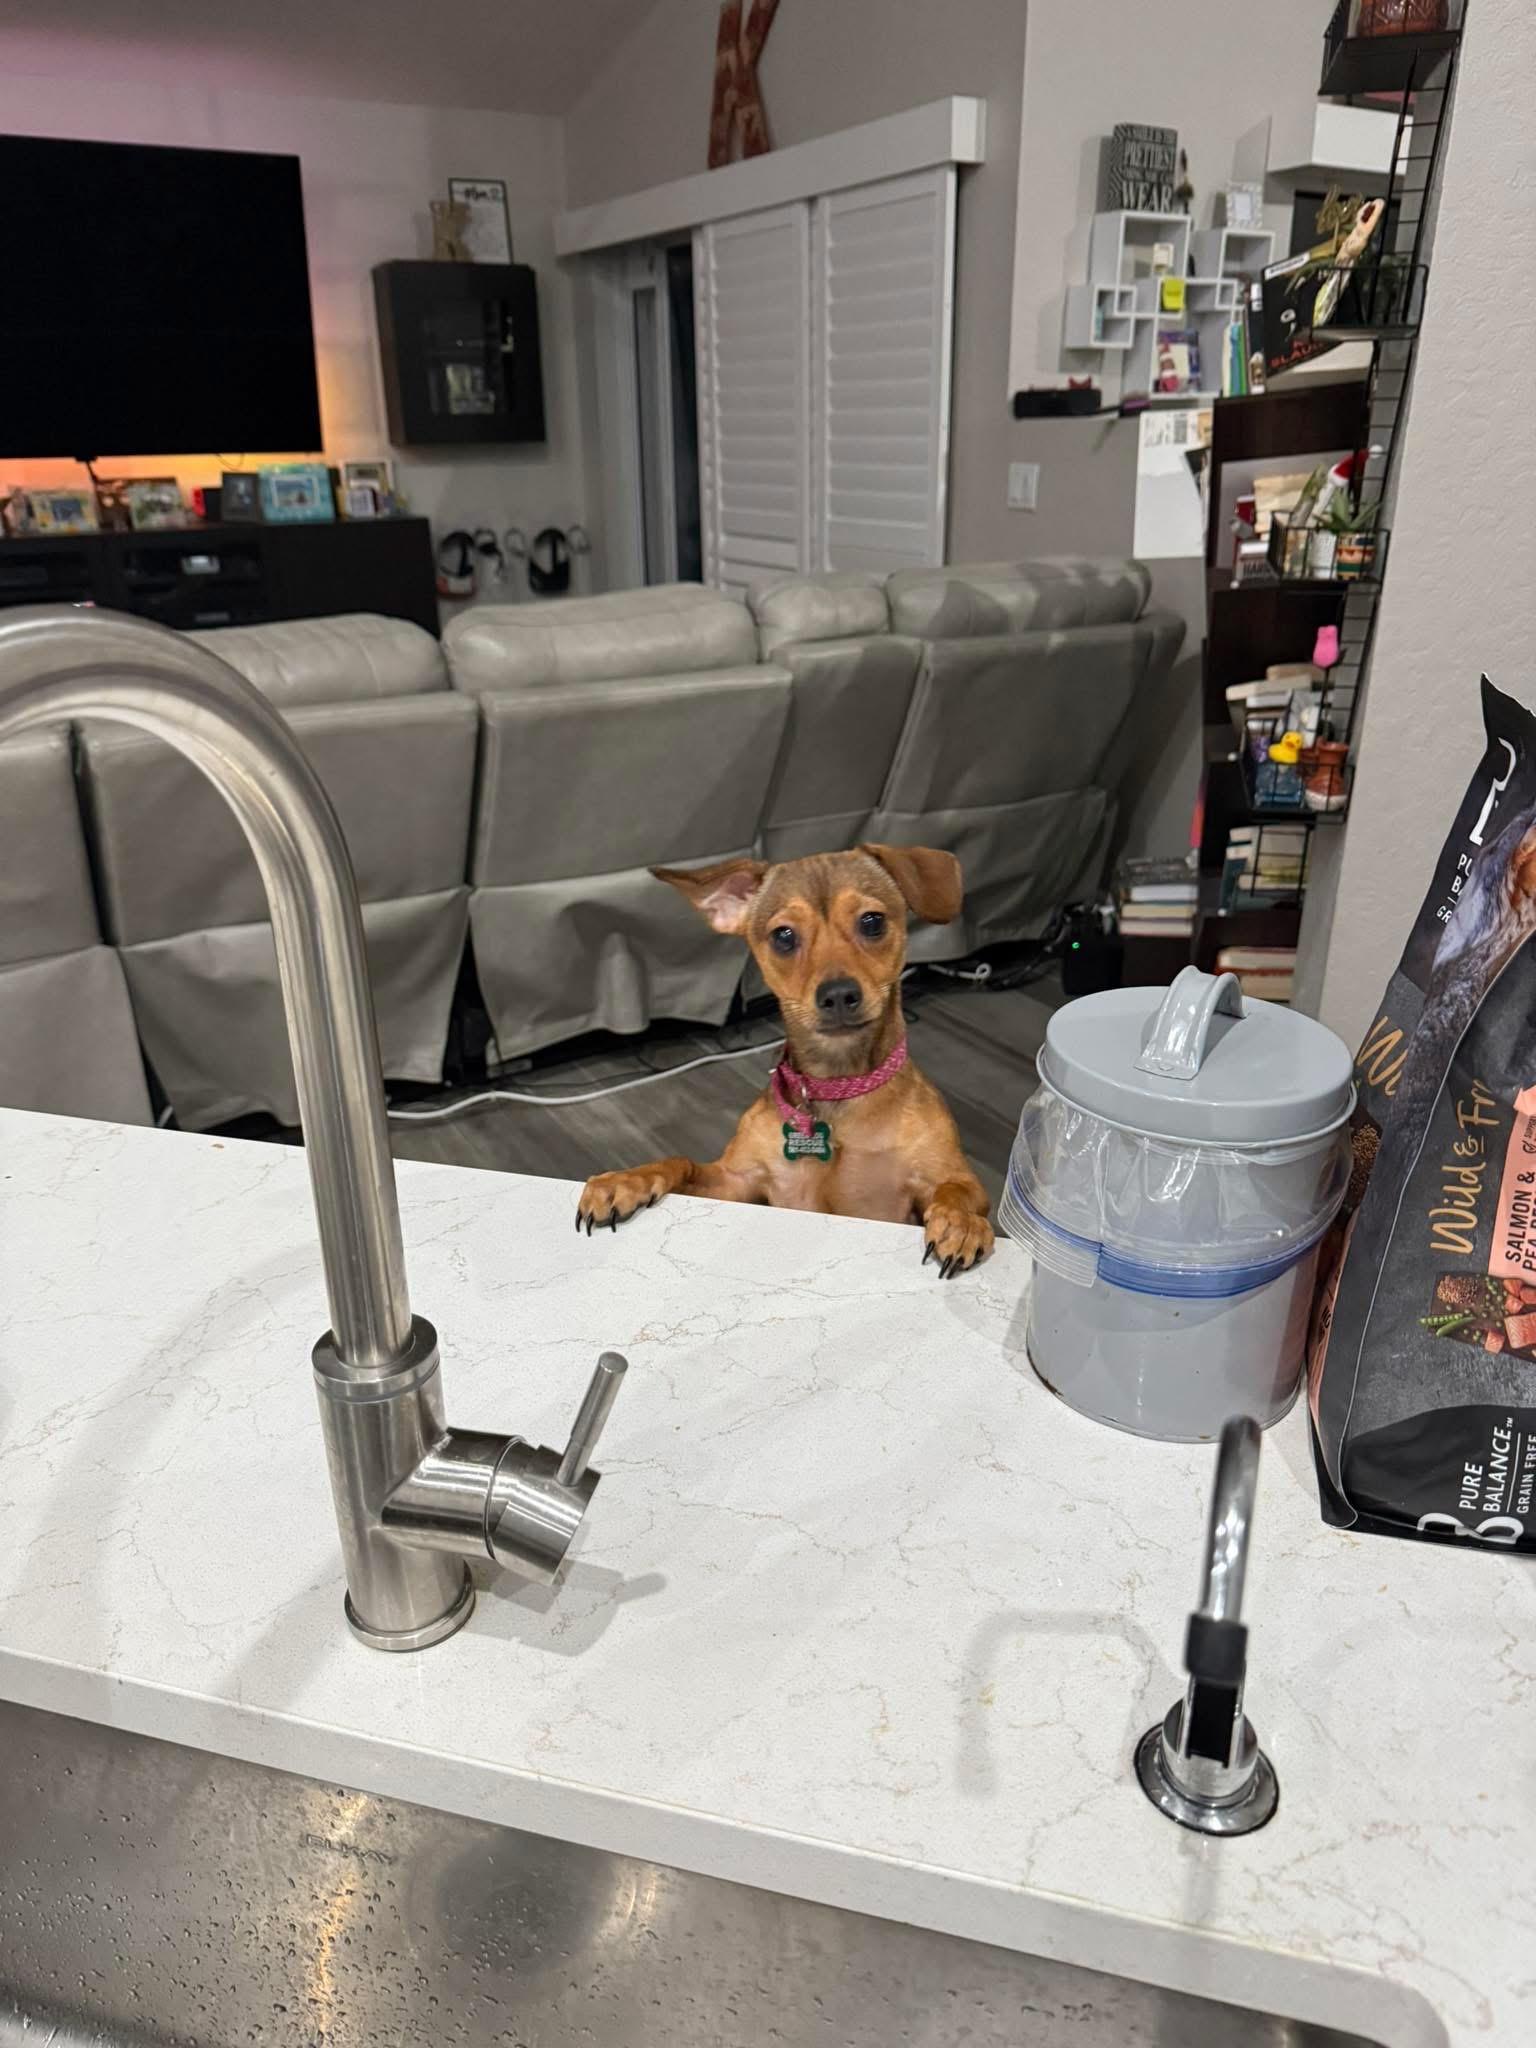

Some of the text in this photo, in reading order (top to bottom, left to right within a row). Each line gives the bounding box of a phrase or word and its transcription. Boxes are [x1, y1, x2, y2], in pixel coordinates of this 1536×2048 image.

[1122, 181, 1172, 213] WEAR
[1453, 1135, 1485, 1157] &
[1428, 1162, 1487, 1255] Wild
[1505, 1171, 1536, 1263] SALMON &
[1459, 1462, 1483, 1510] PURE
[1516, 1434, 1536, 1514] GRAIN FREE
